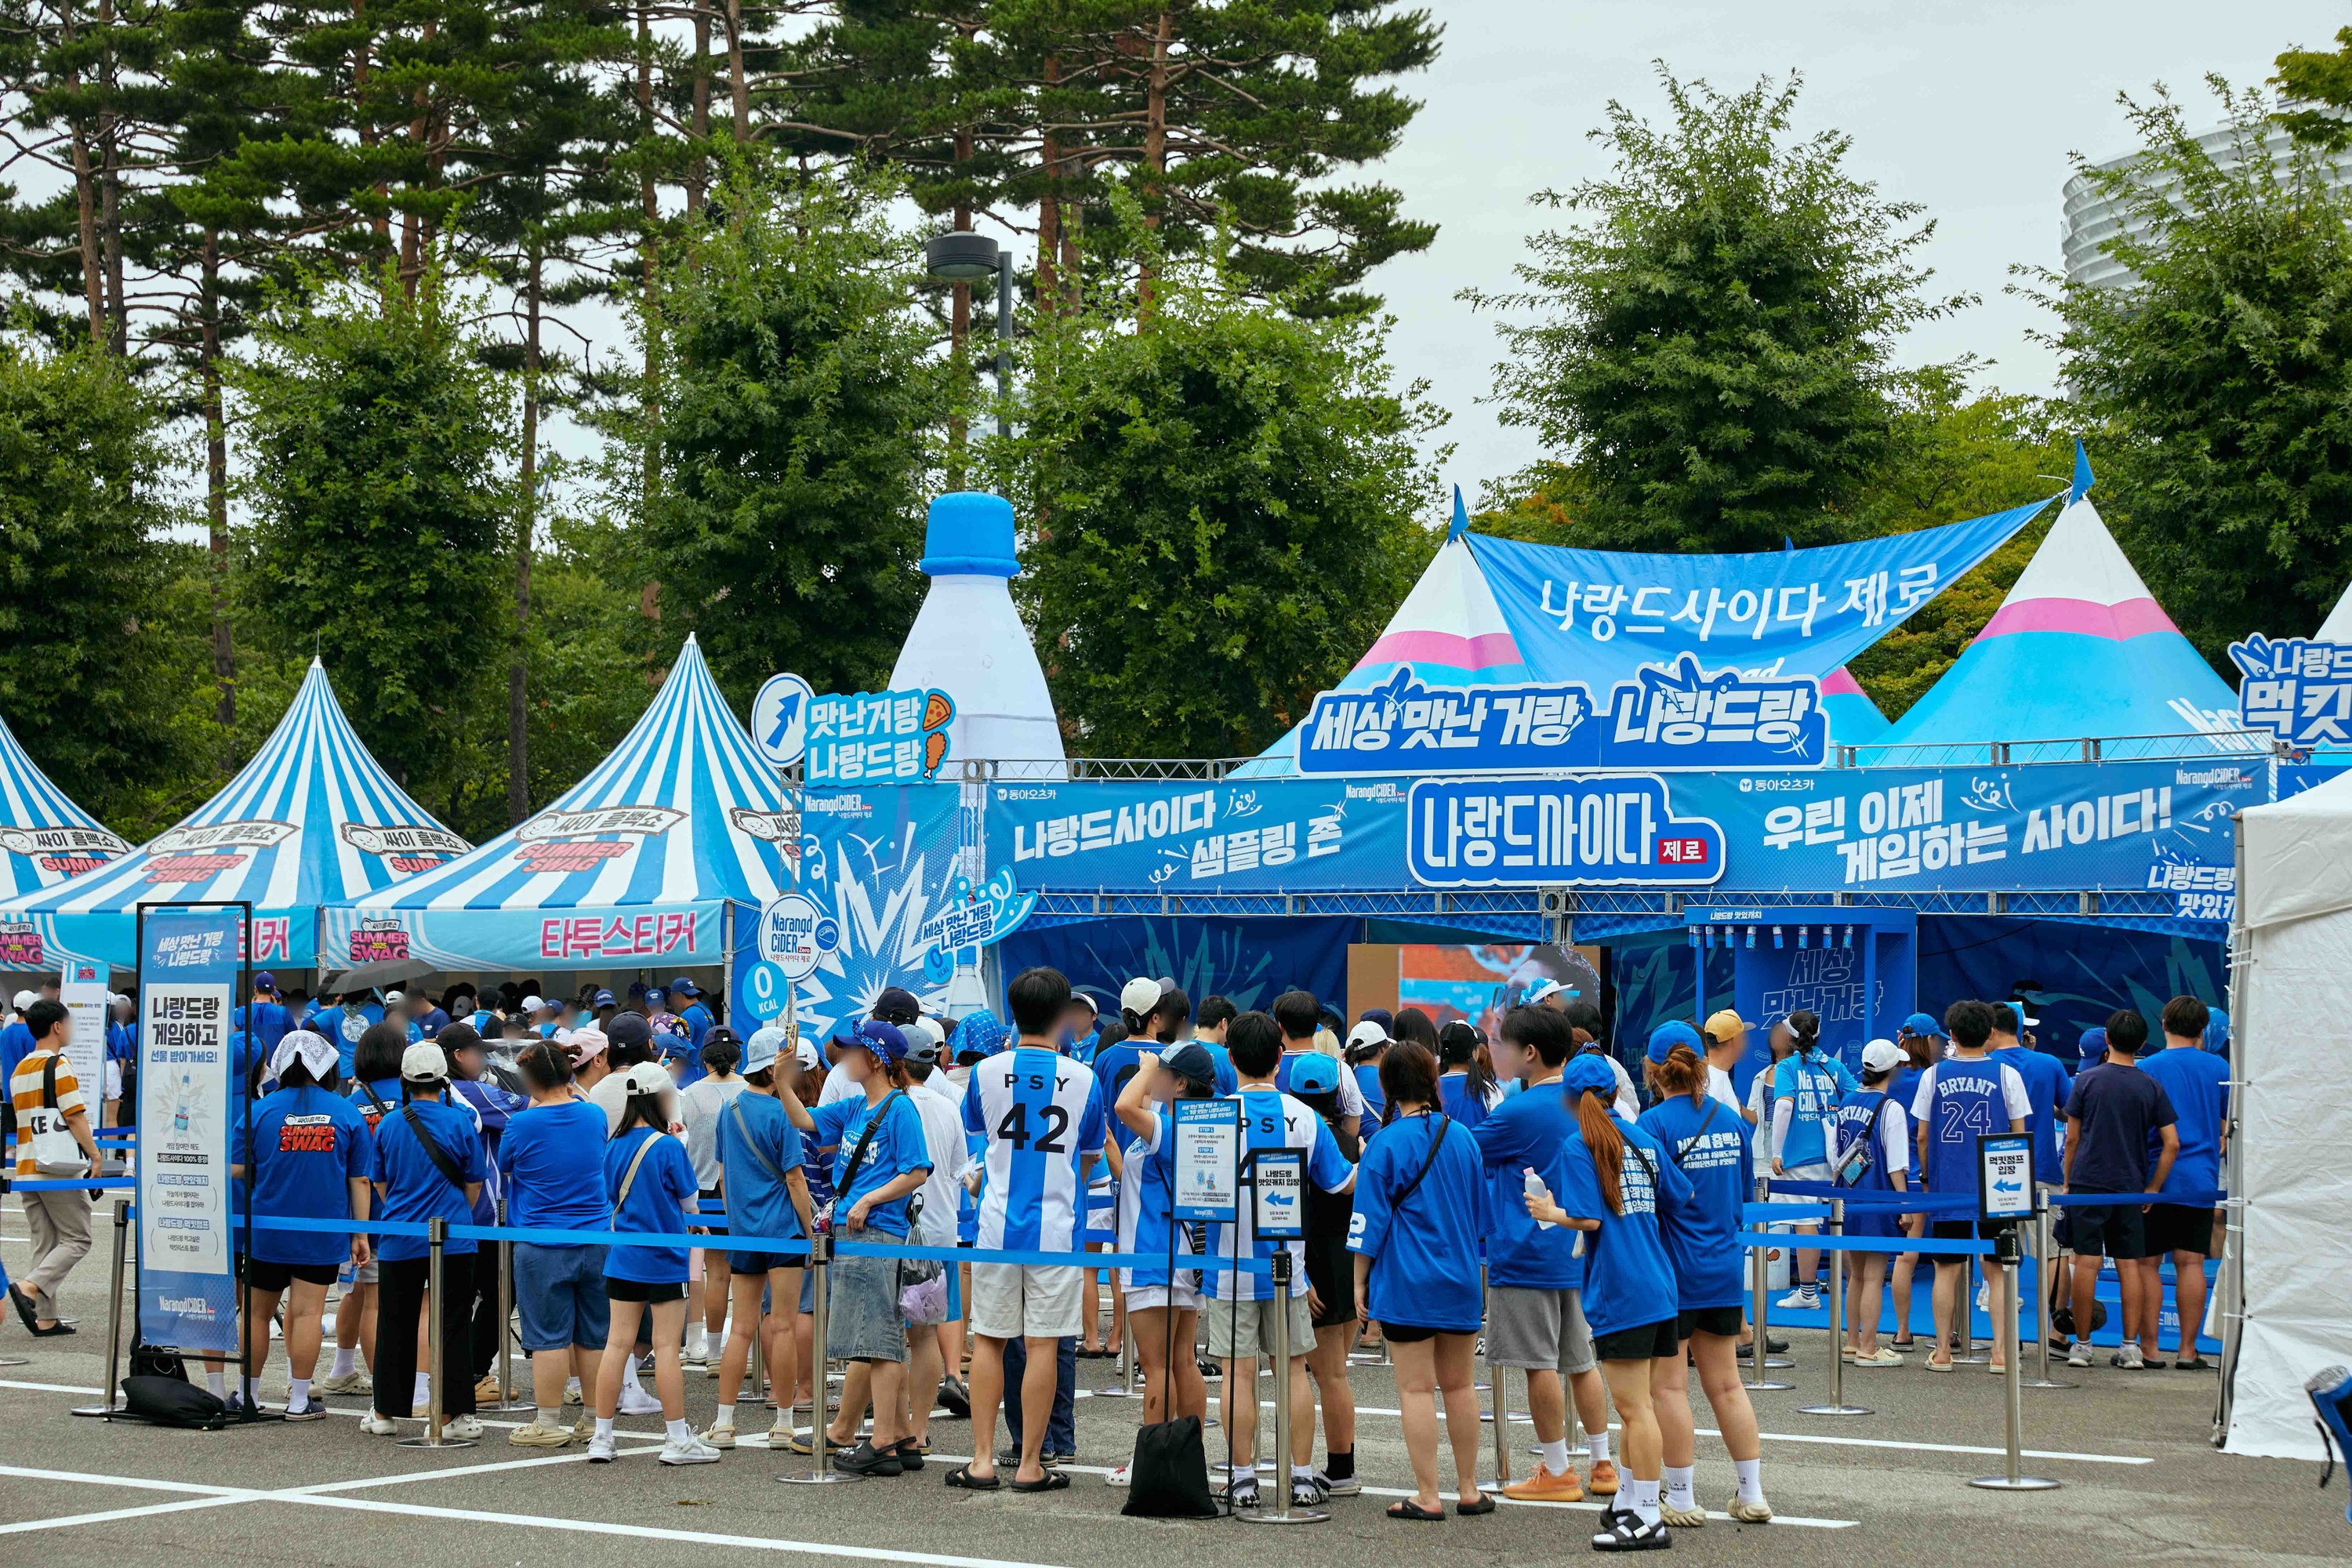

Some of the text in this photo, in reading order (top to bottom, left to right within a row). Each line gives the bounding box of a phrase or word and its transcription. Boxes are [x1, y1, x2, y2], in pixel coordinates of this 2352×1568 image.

[1540, 563, 1938, 641] 나랑드사이다 제로
[810, 695, 920, 739] 맛난거랑
[1311, 689, 1811, 751] 세상 맛난 거랑 나랑드랑
[810, 740, 920, 780] 나랑드랑
[1009, 788, 1056, 800] 동아오츠카
[1755, 779, 1815, 792] 동아오츠카
[554, 811, 663, 832] 싸이 흠뻑쇼
[1763, 779, 1943, 851] 우린 이제
[183, 825, 278, 844] 싸이 흠뻑쇼
[1014, 789, 1216, 862] 나랑드사이다
[1425, 792, 1703, 866] 나랑드사이다 제로
[36, 833, 118, 848] 싸이 흠뻑쇼
[383, 831, 462, 850] 싸이 흠뻑쇼
[1838, 786, 2172, 885] 게임하는 사이다!
[514, 841, 634, 860] SUMMER
[1191, 815, 1341, 880] 샘플링 존
[142, 854, 249, 873] SUMMER
[521, 857, 600, 873] SWAG
[146, 869, 216, 884] SWAG
[772, 913, 812, 938] Narangd
[924, 903, 991, 939] 세상 맛난 거랑
[158, 930, 224, 953] 세상 맛난 거랑
[350, 931, 408, 943] SUMMER
[541, 911, 696, 959] 타투스티커
[771, 934, 798, 953] CiDER
[942, 918, 993, 951] 나랑드랑
[168, 948, 212, 967] 나랑드랑
[350, 944, 409, 961] SWAG
[930, 949, 942, 968] 0
[936, 966, 949, 978] KCAL
[1788, 946, 1854, 986] 세상
[754, 966, 772, 998] 0
[153, 996, 220, 1020] 나랑드랑
[758, 998, 779, 1014] KCAL
[152, 1023, 218, 1046] 게임하고
[151, 1051, 217, 1062] 선물 받아가세요!
[1005, 1073, 1070, 1092] PSY
[1937, 1077, 1997, 1098] BRYANT
[997, 1102, 1069, 1153] 42
[1941, 1101, 1991, 1142] 24
[280, 1126, 336, 1137] SUMMER
[1711, 1133, 1740, 1149] 흠뻑쇼
[279, 1136, 336, 1152] SWAG
[1989, 1155, 2024, 1165] 먹킷점프
[158, 1174, 182, 1185] 나랑드랑
[1998, 1165, 2016, 1175] 입장
[158, 1218, 183, 1229] 나랑드랑
